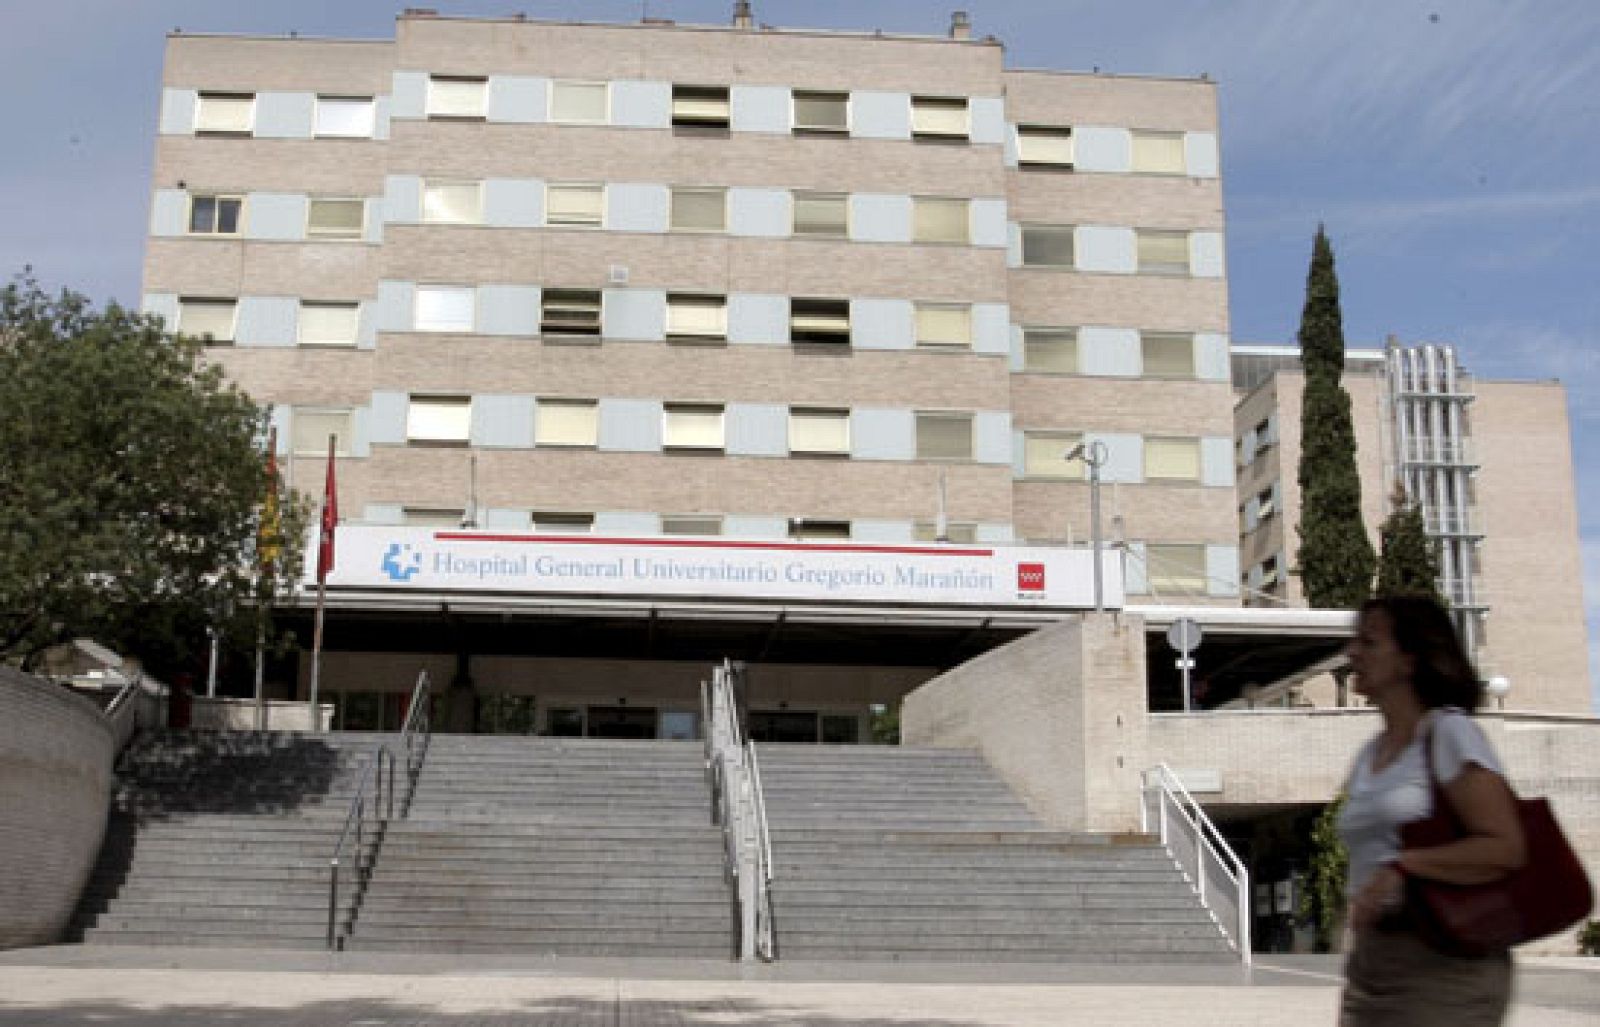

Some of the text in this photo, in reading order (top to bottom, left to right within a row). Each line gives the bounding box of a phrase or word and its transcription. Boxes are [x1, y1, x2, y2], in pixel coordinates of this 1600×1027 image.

[432, 552, 993, 590] Hospital General Universitario Gregorio Marañón
